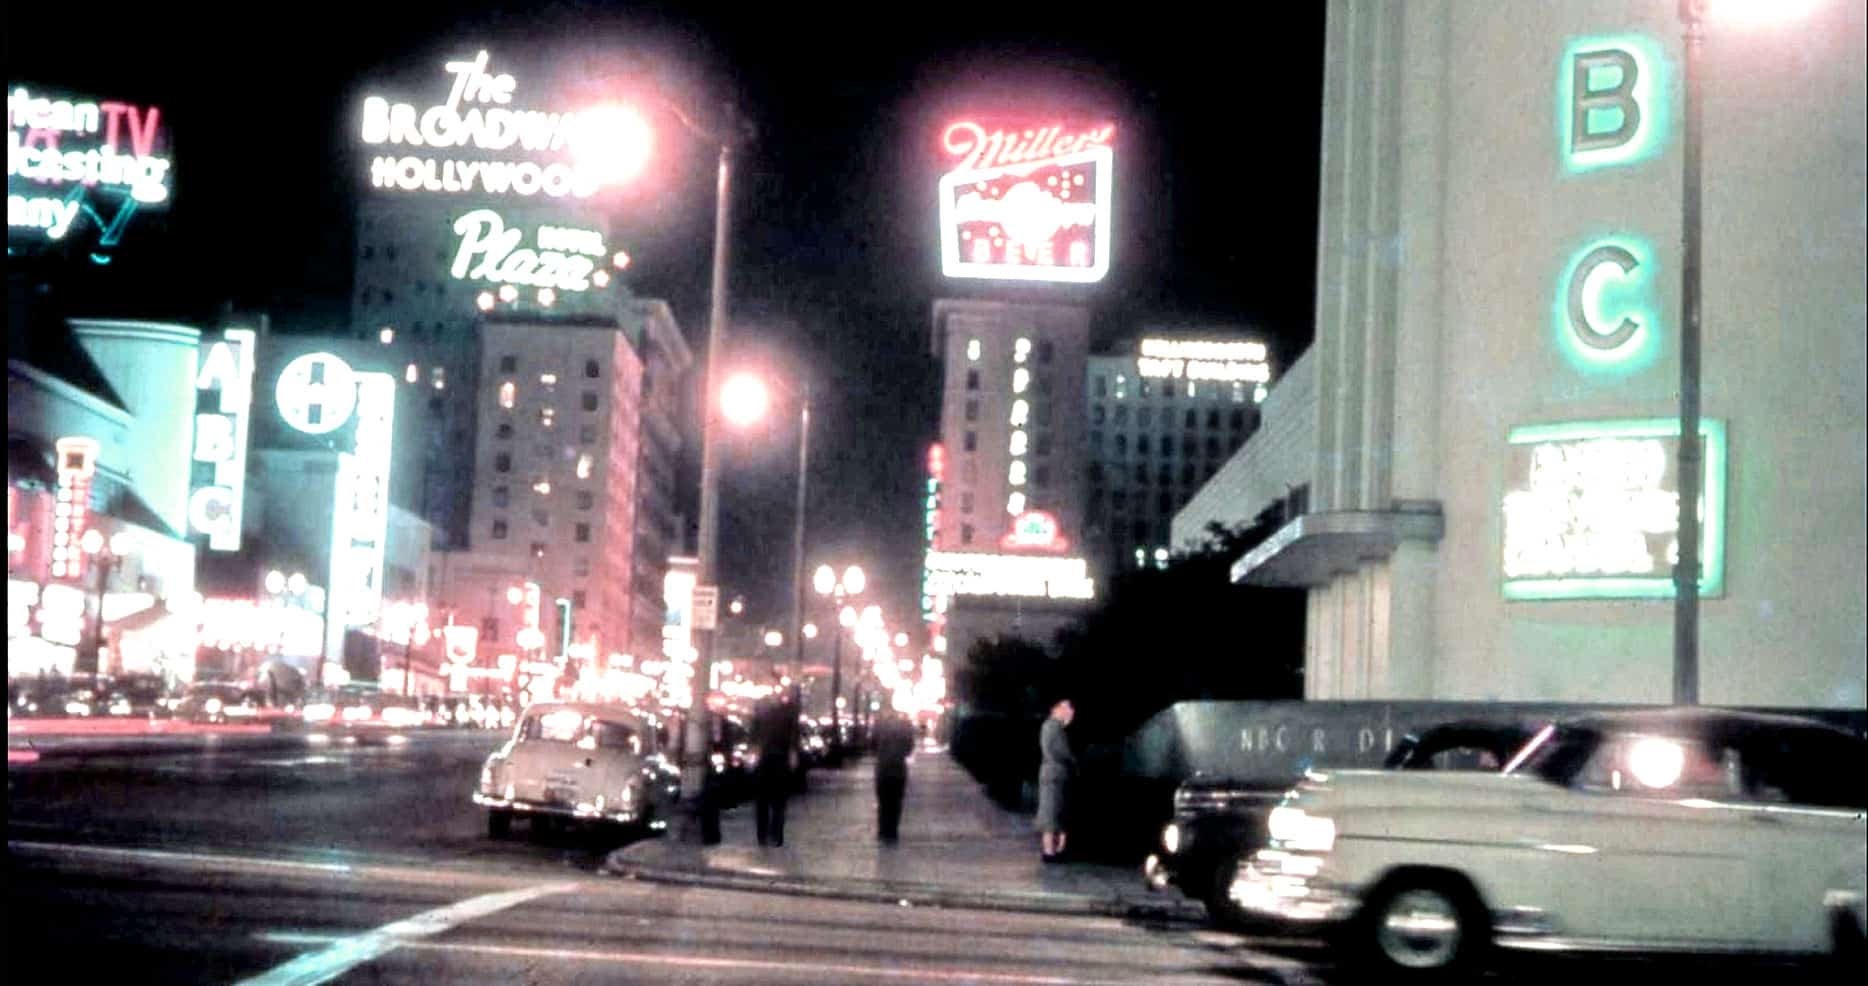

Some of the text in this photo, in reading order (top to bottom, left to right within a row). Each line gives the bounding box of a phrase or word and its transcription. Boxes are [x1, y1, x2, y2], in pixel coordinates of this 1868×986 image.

[446, 50, 517, 112] The
[362, 97, 602, 151] BROADWA
[450, 209, 595, 292] Plaza
[189, 340, 241, 535] ABC
[1312, 726, 1396, 752] RDI
